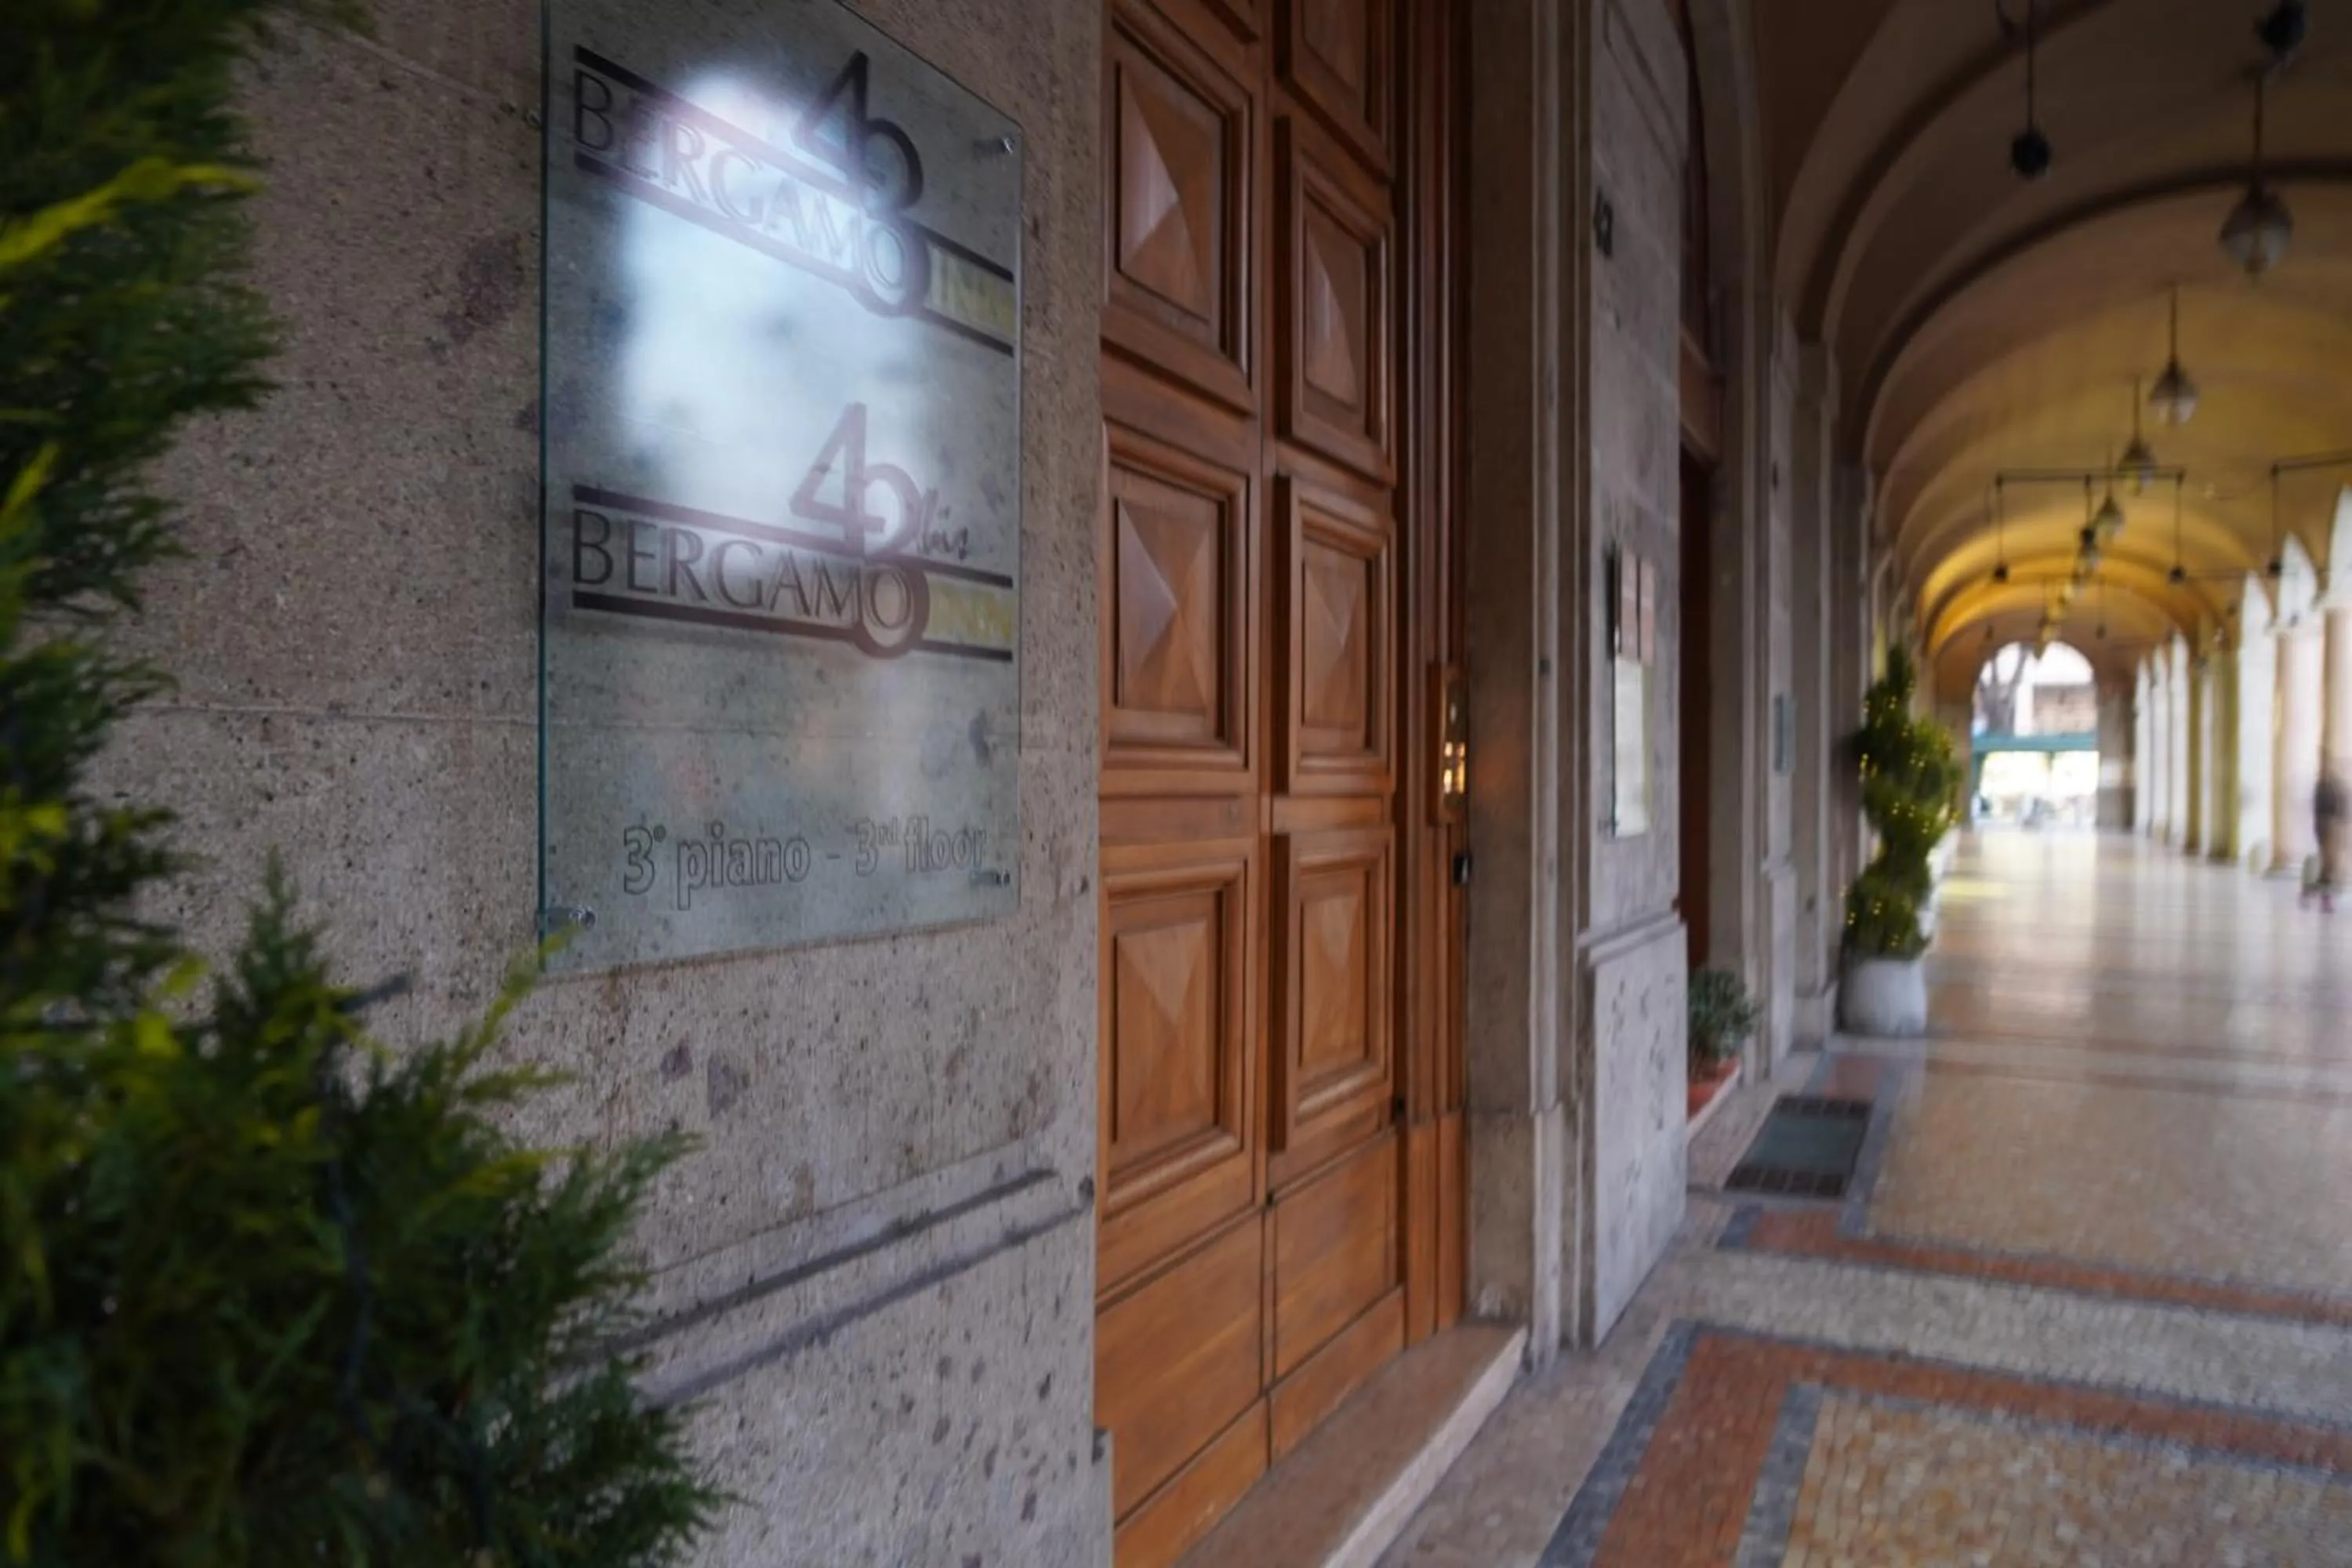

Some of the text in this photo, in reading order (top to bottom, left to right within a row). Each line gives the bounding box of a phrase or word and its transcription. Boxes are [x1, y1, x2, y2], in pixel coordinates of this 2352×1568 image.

[572, 508, 913, 629] BERGAMO
[677, 820, 811, 911] piano
[904, 814, 987, 874] floor
